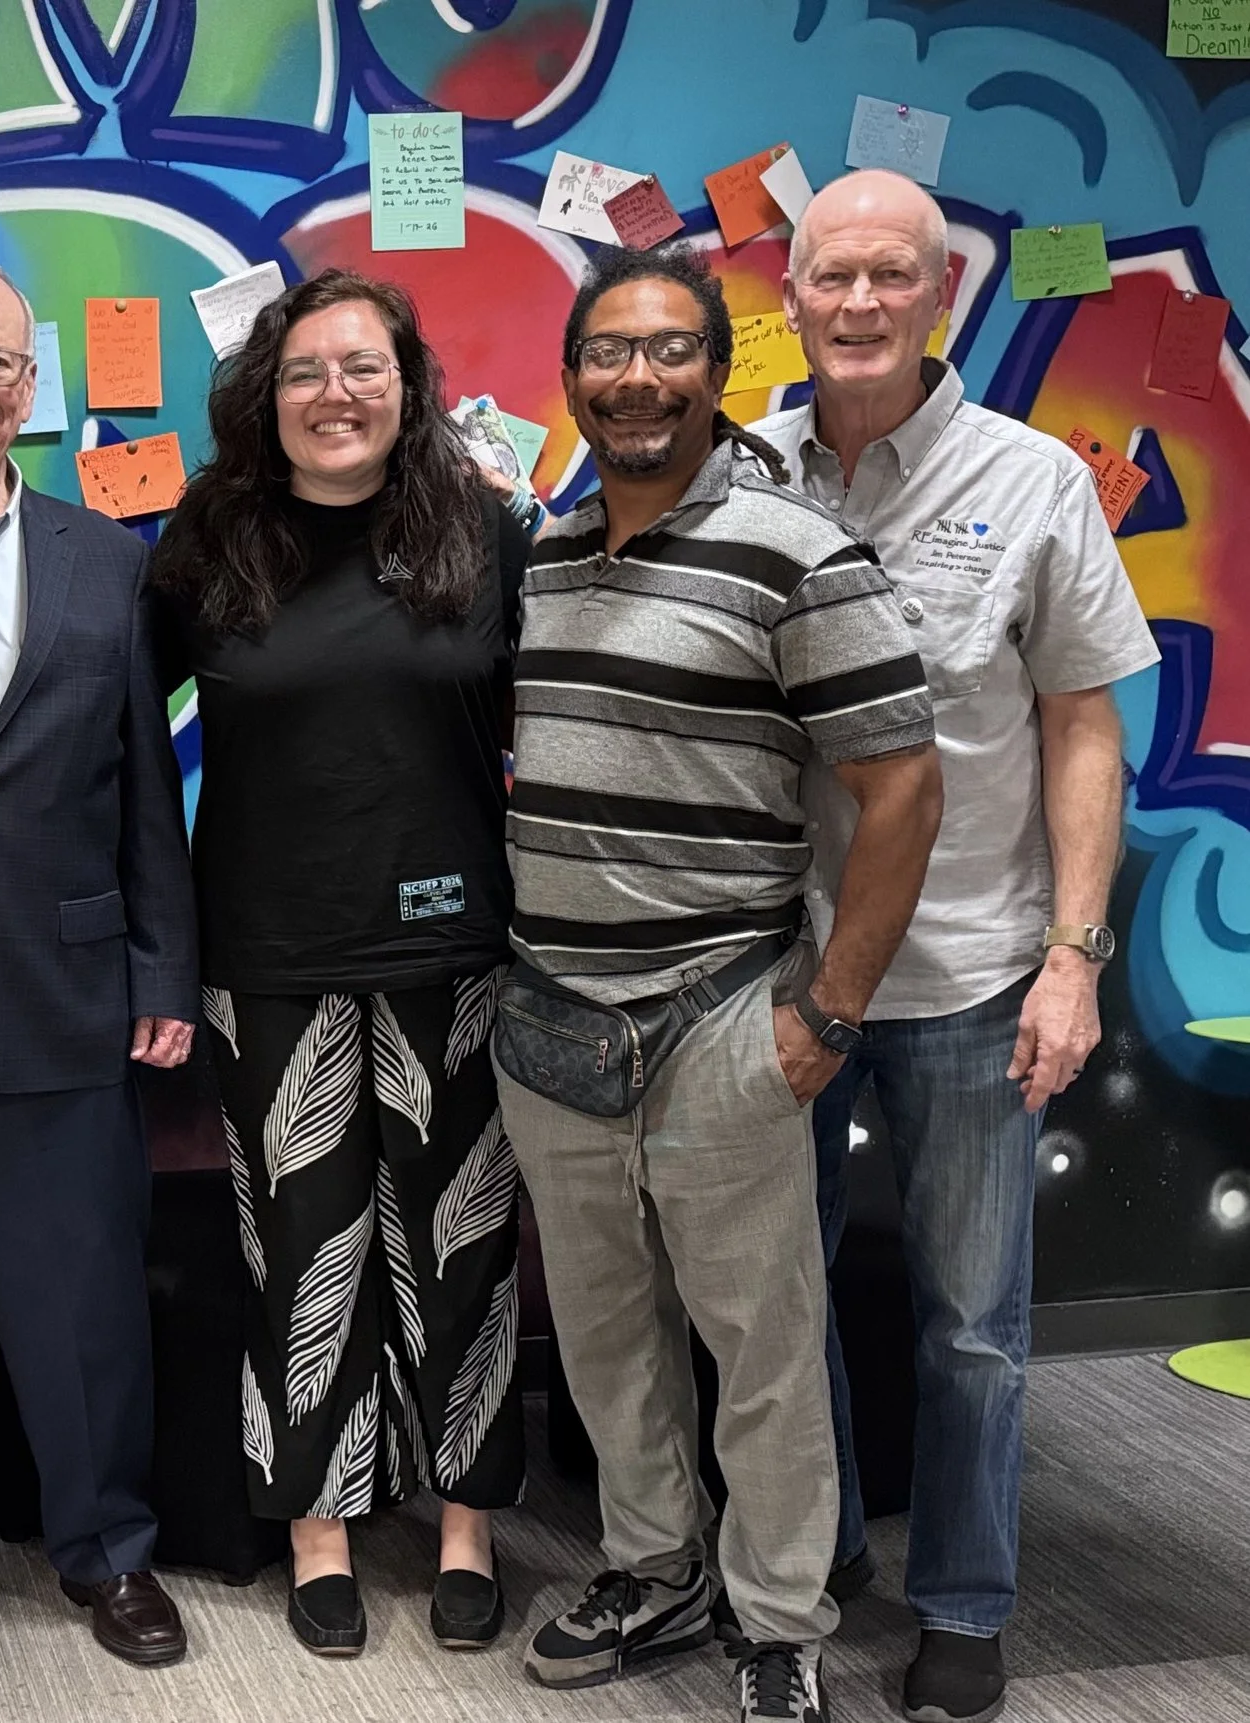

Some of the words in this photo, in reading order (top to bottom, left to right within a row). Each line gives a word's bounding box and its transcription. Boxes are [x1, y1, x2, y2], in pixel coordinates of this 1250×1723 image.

[1171, 19, 1203, 31] Action
[1103, 465, 1135, 518] INTENT
[969, 538, 1006, 552] Justice
[946, 551, 982, 563] Peterson
[963, 564, 992, 576] change
[403, 881, 438, 893] NCHEP
[441, 877, 461, 887] 2026
